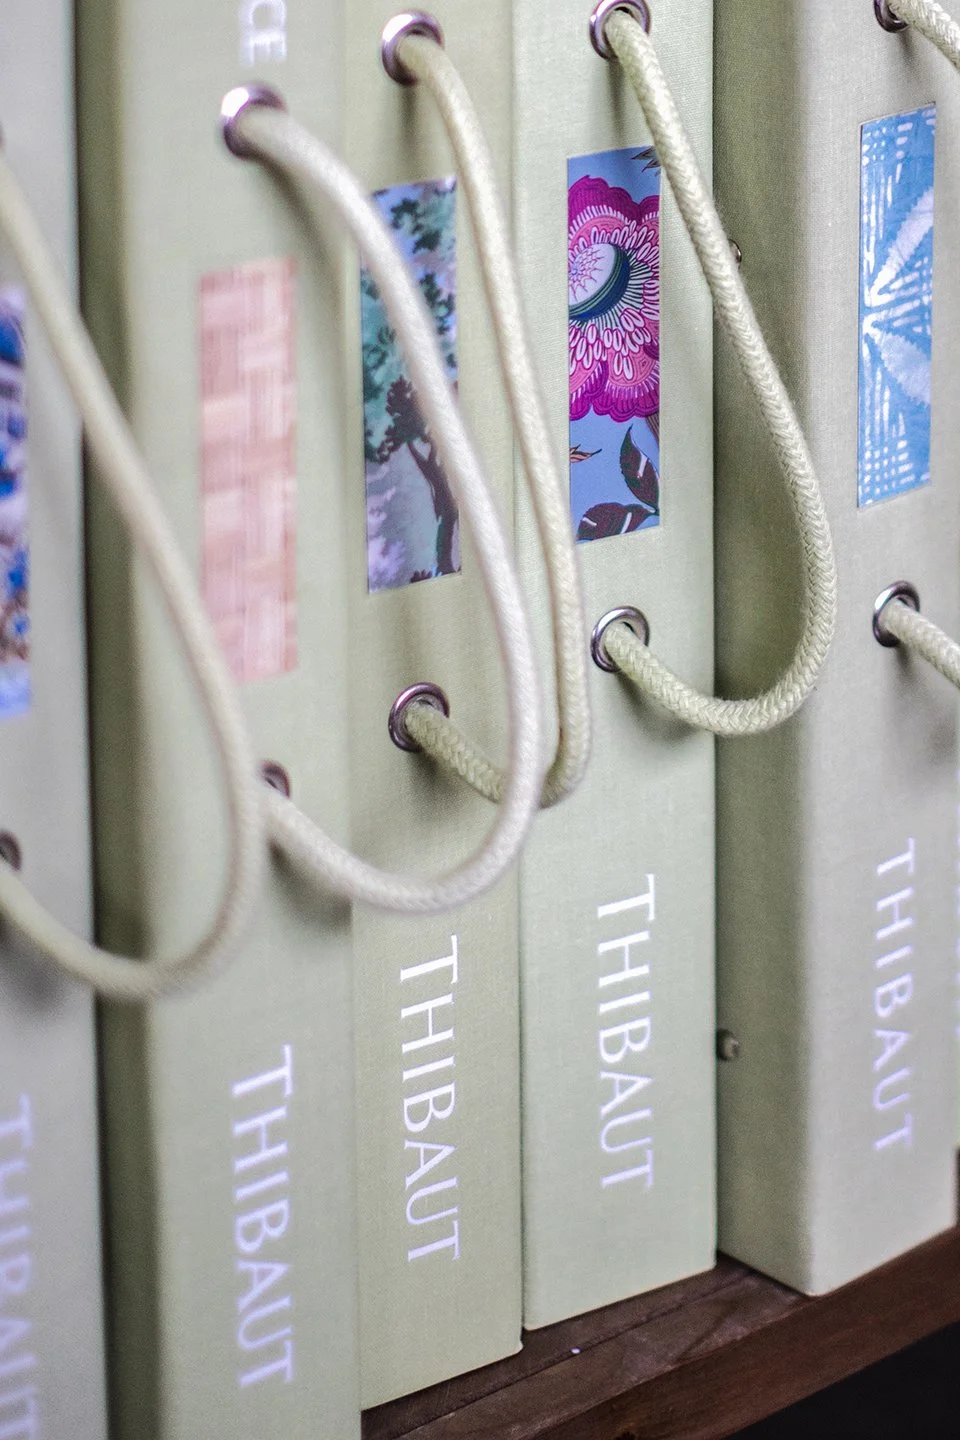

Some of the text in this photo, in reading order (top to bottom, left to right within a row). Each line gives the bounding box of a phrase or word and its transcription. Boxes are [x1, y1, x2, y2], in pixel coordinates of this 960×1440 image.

[399, 935, 460, 1261] THIBAUT
[597, 874, 656, 1187] THIBAUT
[873, 838, 916, 1150] THIBAUT
[232, 1043, 294, 1386] THIBAUT
